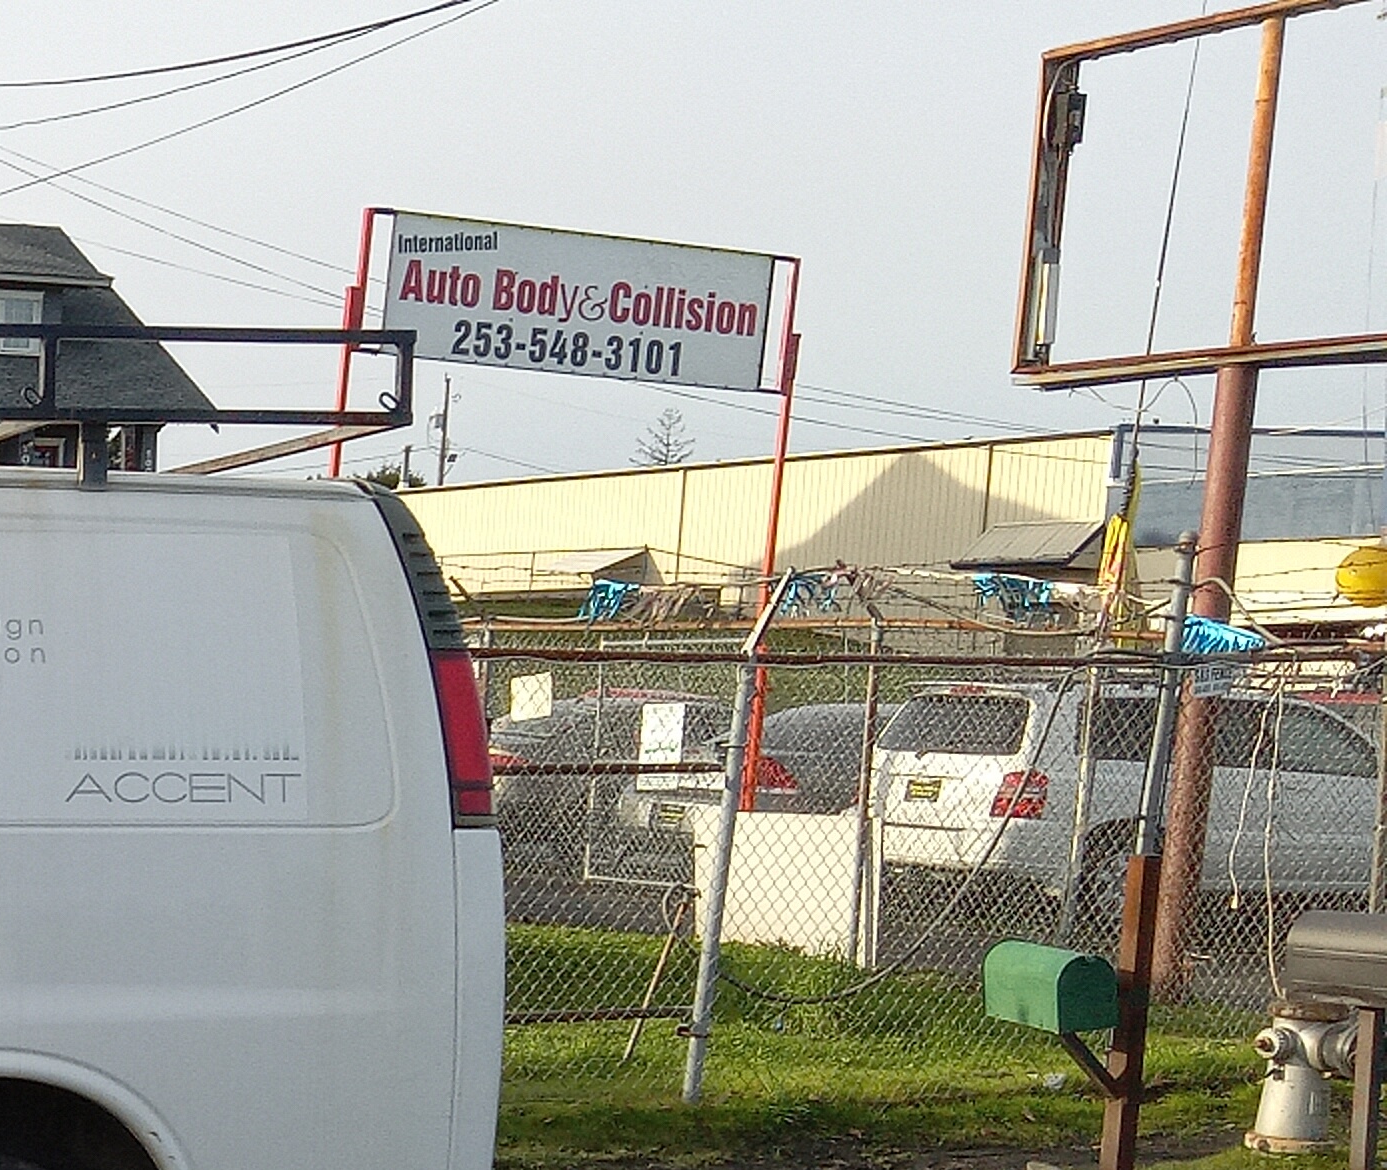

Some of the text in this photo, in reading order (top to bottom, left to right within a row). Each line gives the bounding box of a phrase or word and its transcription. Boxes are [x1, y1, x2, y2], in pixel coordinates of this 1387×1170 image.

[398, 231, 499, 253] International
[399, 259, 481, 309] Auto
[451, 319, 683, 377] 253-548-3101
[65, 771, 302, 804] ACCENT
